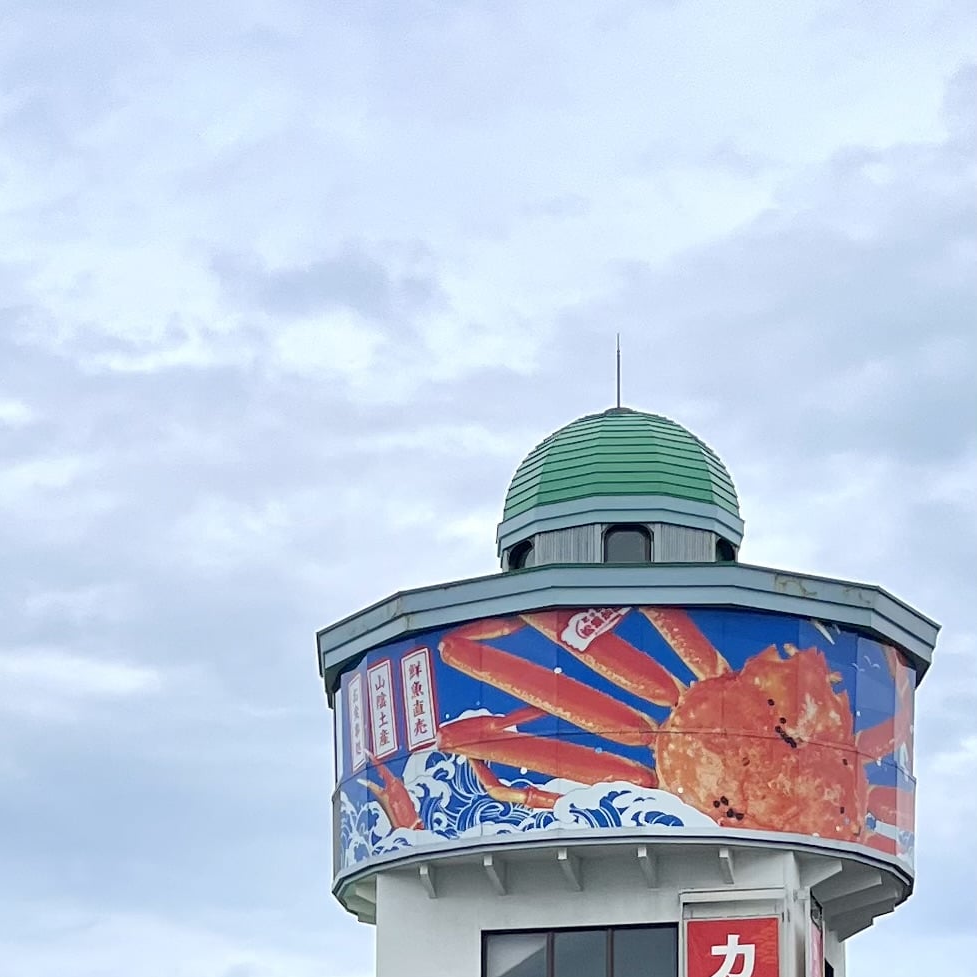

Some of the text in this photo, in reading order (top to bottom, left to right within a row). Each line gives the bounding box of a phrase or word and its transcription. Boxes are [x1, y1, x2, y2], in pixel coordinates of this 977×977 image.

[375, 674, 390, 747] 山陰土産
[409, 660, 428, 737] 鮮魚直売
